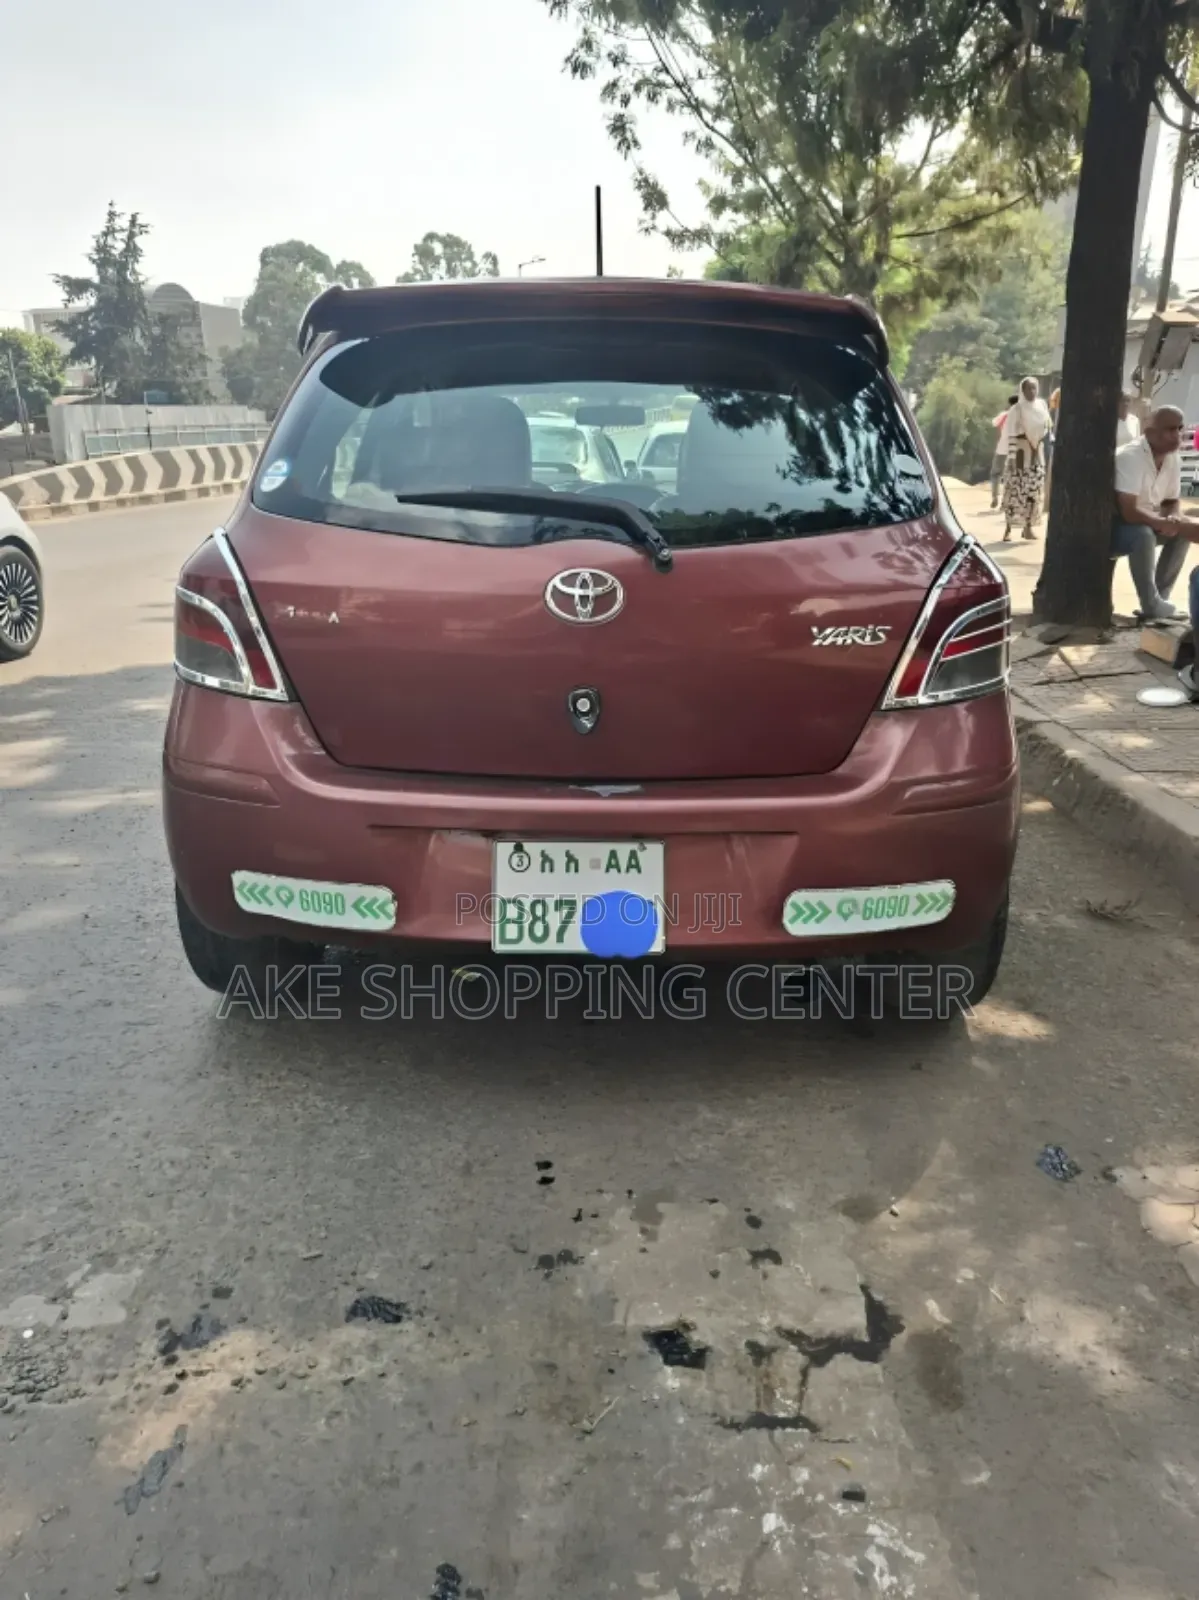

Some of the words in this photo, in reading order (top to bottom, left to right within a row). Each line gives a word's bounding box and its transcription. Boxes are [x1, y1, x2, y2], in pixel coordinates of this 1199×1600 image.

[604, 849, 642, 875] AA
[299, 887, 346, 916] 6090
[861, 894, 910, 921] 6090
